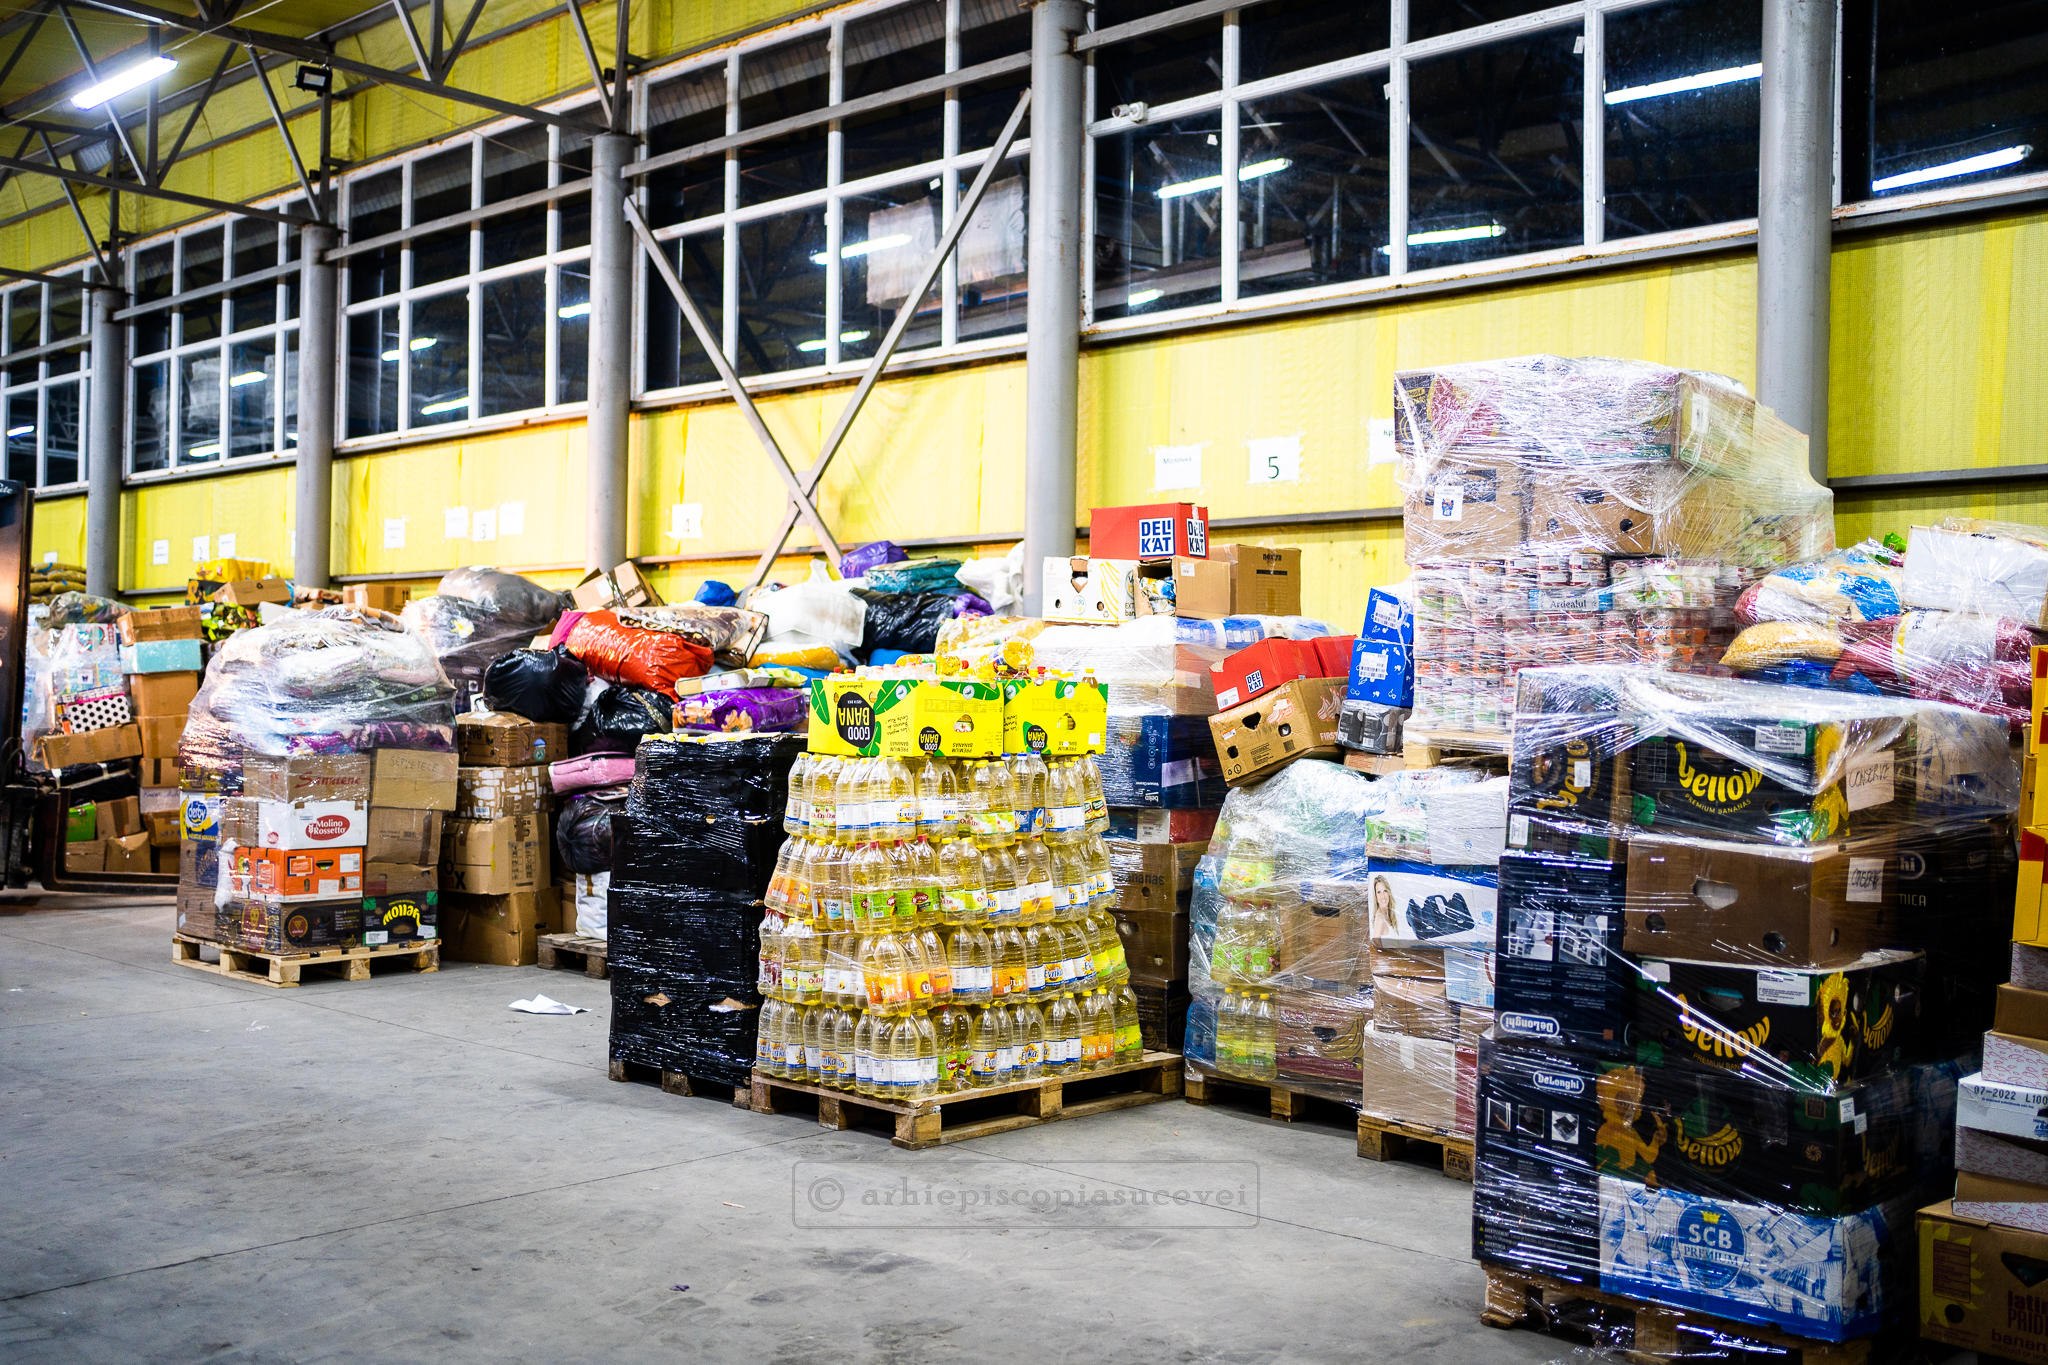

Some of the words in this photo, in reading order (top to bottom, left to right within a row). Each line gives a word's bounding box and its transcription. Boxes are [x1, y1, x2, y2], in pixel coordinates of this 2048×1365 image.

[1268, 456, 1280, 479] 5
[837, 707, 870, 726] BANA
[847, 726, 871, 741] GOOD
[920, 733, 939, 744] BANA
[1684, 793, 1716, 814] PREMIUM
[1717, 798, 1752, 815] BANANAS
[313, 826, 346, 836] Rossetto
[316, 819, 343, 828] Molino
[1973, 1085, 2017, 1101] 07-2022
[1688, 1224, 1733, 1250] SCB
[1683, 1246, 1739, 1267] PREMIUM
